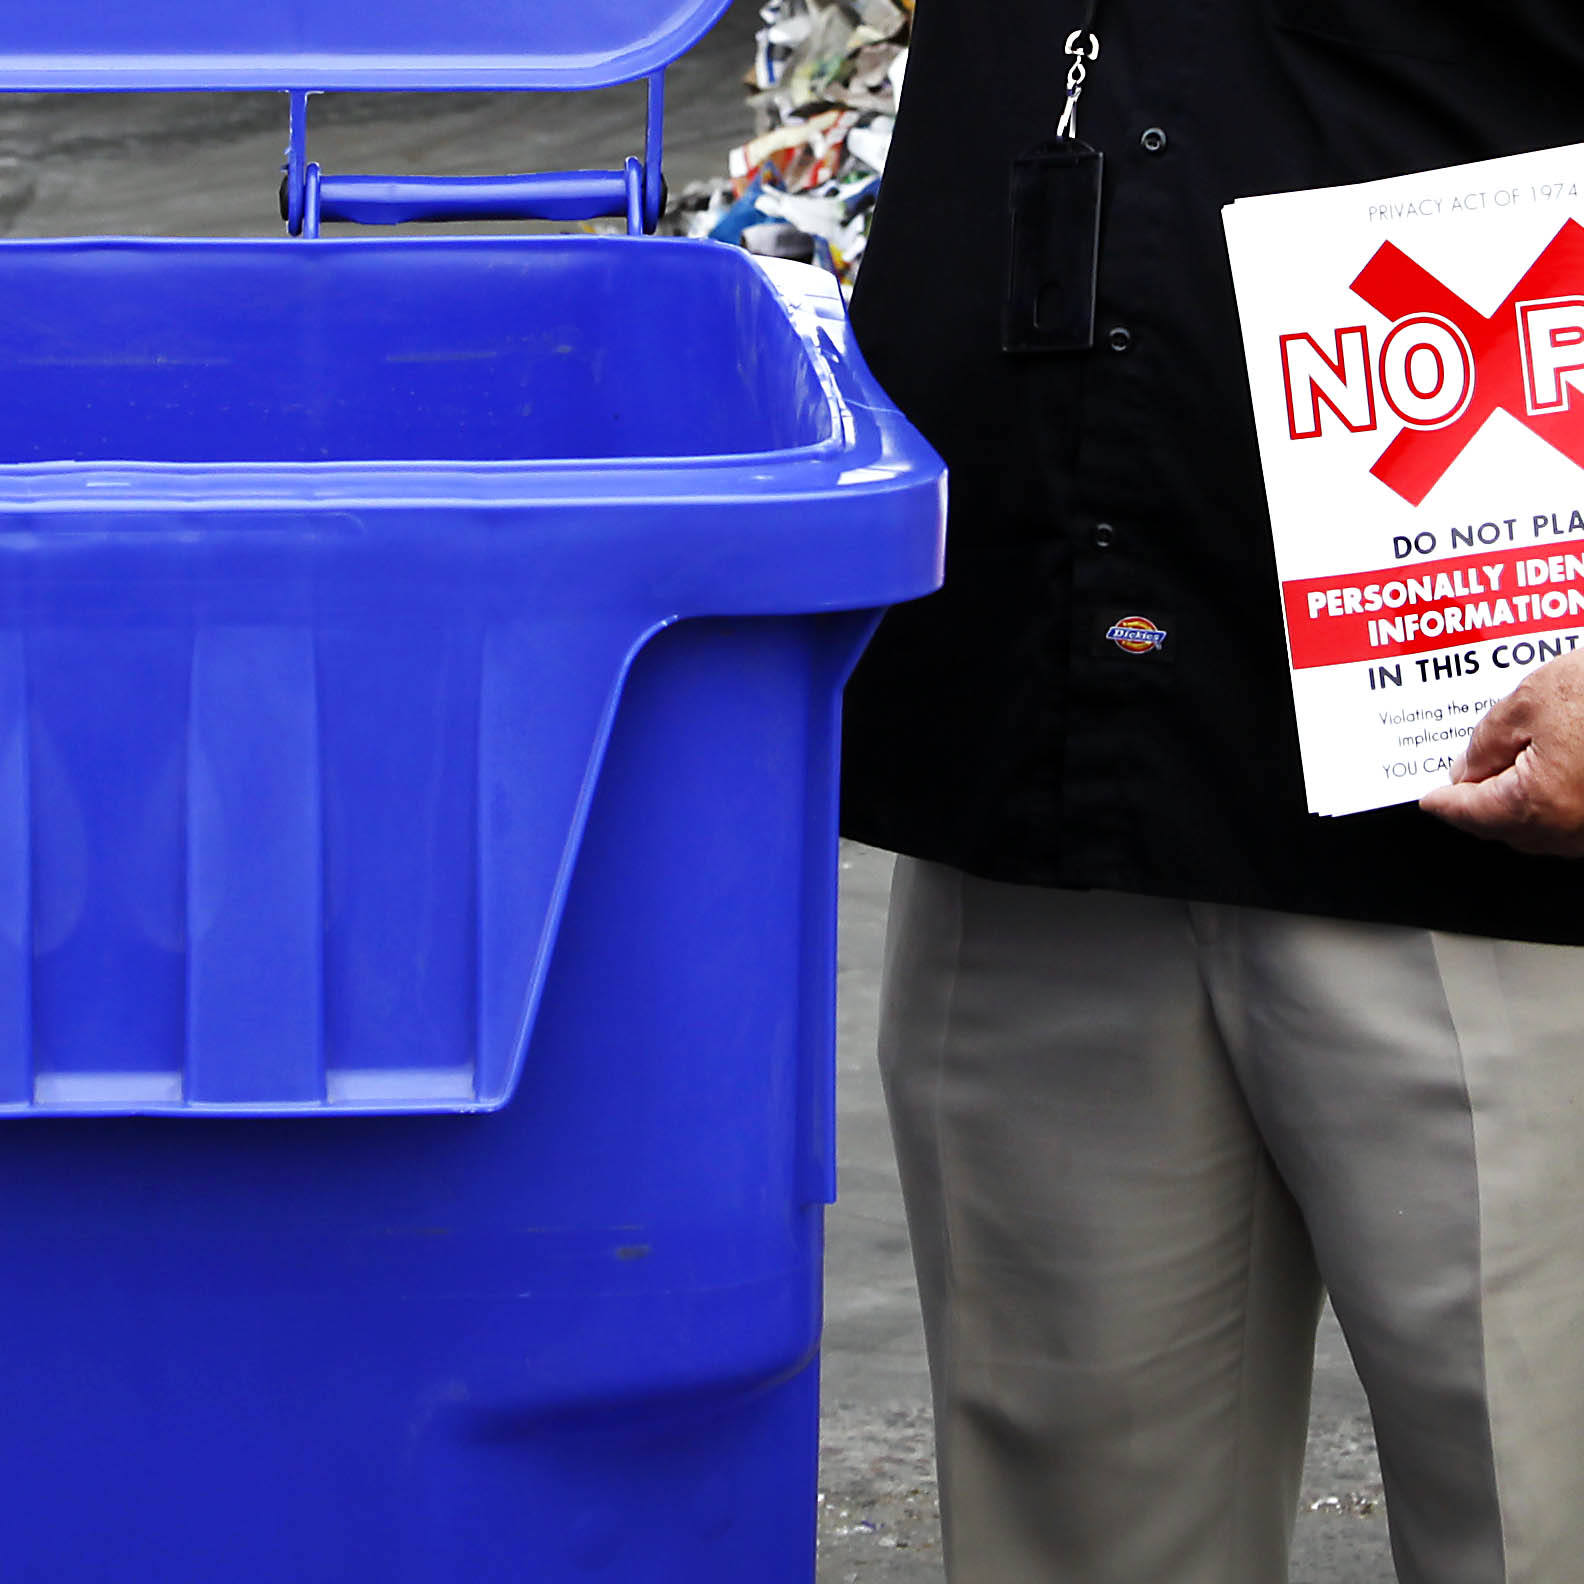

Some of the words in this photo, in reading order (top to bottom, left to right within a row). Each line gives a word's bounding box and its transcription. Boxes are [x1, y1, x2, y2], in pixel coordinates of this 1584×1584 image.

[1368, 198, 1443, 223] PRIVACY
[1451, 192, 1487, 212] ACT
[1494, 188, 1520, 207] OF
[1531, 182, 1579, 202] 1974
[1279, 314, 1474, 441] NO
[1392, 530, 1437, 560] DO
[1450, 518, 1517, 550] NOT
[1307, 562, 1504, 619] PERSONALLY
[1112, 628, 1161, 642] Dickies
[1368, 663, 1403, 691] IN
[1414, 649, 1480, 683] THIS
[1378, 706, 1444, 726] Violating
[1447, 699, 1469, 716] the
[1398, 725, 1476, 748] implication
[1382, 760, 1418, 779] YOU
